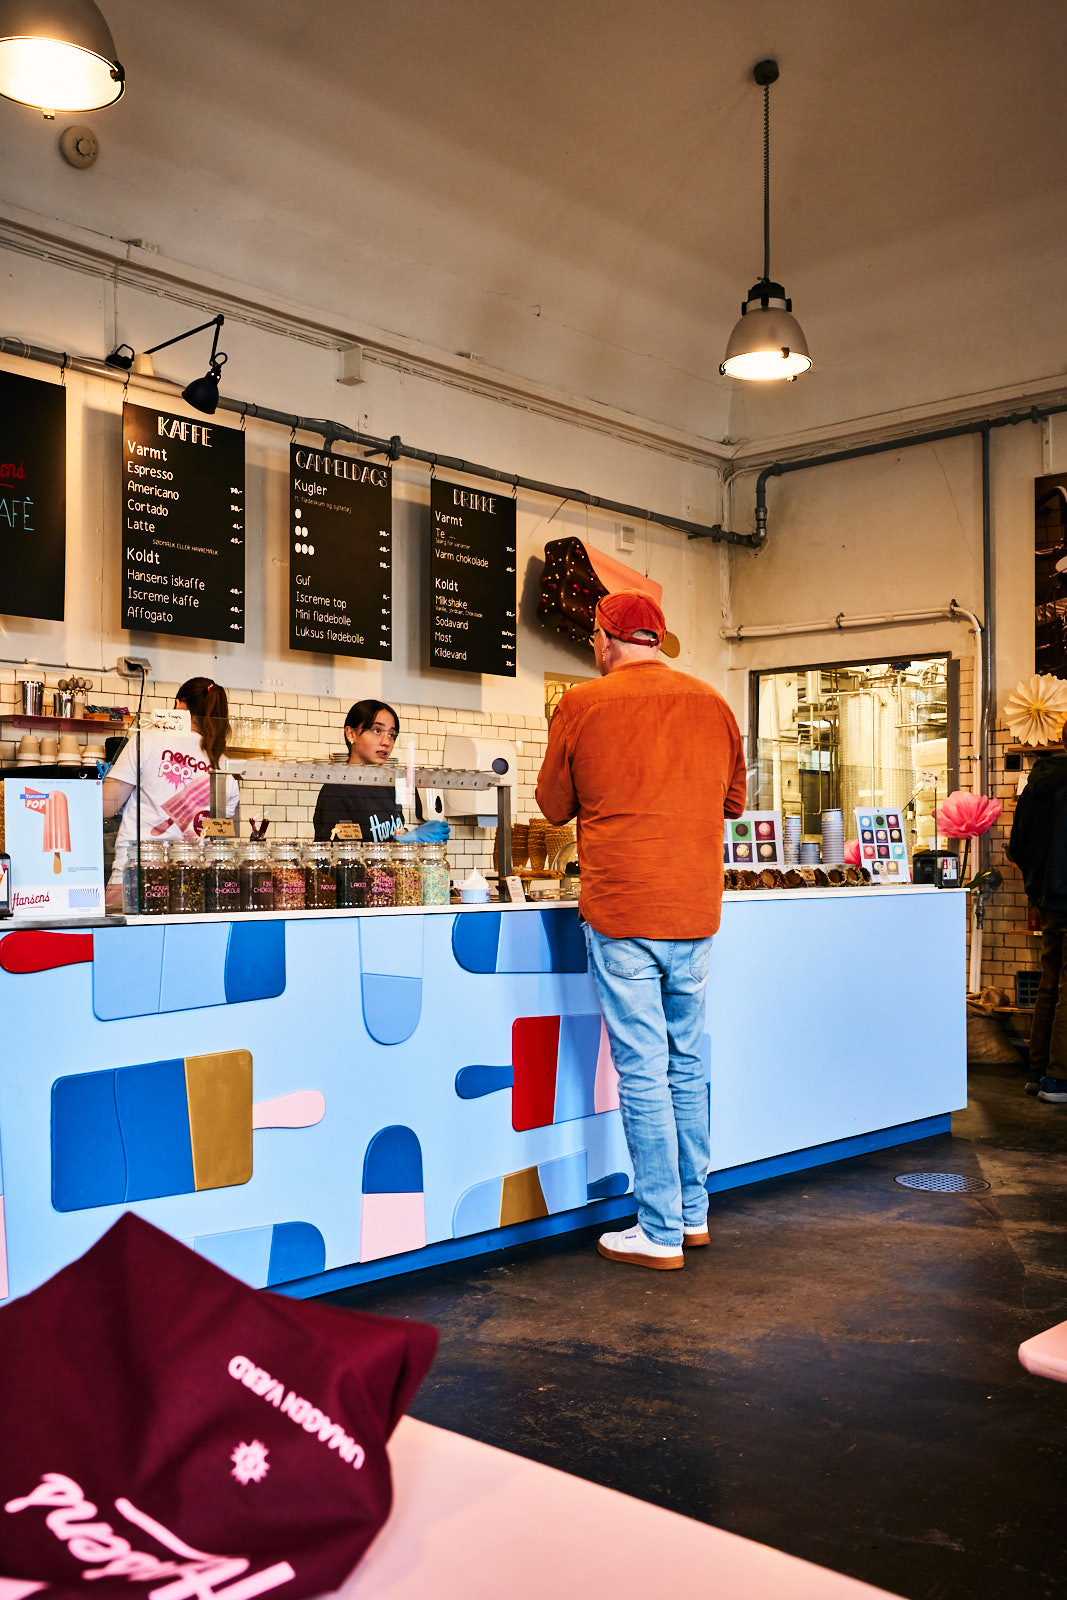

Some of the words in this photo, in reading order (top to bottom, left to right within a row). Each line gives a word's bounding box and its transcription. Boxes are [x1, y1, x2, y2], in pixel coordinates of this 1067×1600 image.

[158, 416, 212, 447] KAFFE
[128, 440, 167, 461] Varmt
[128, 461, 173, 480] Espresso
[128, 480, 179, 500] Americano
[295, 478, 327, 496] Kugler
[128, 499, 168, 516] Cortado
[454, 488, 496, 515] DRIKKE
[128, 518, 155, 532] Latte
[435, 510, 463, 527] Varmt
[436, 528, 445, 539] Te
[127, 547, 160, 565] Koldt
[435, 549, 454, 560] Varm
[455, 552, 489, 568] chokolade
[127, 569, 168, 585] Hansens
[171, 575, 205, 591] iskaffe
[296, 574, 311, 586] Guf
[435, 578, 458, 592] Koldt
[128, 587, 170, 604] Iscreme
[173, 594, 199, 608] kaffe
[296, 591, 330, 607] Iscreme
[333, 598, 347, 611] top
[127, 606, 173, 623] Affogato
[295, 608, 310, 620] Mini
[313, 610, 351, 626] flødebolle
[435, 616, 468, 630] Sodavand
[295, 626, 324, 639] Luksus
[327, 630, 364, 644] flødebolle
[435, 632, 452, 643] Most
[434, 648, 467, 660] Kildevand
[158, 760, 192, 781] pop
[26, 800, 45, 809] POP
[12, 892, 50, 910] Hansens
